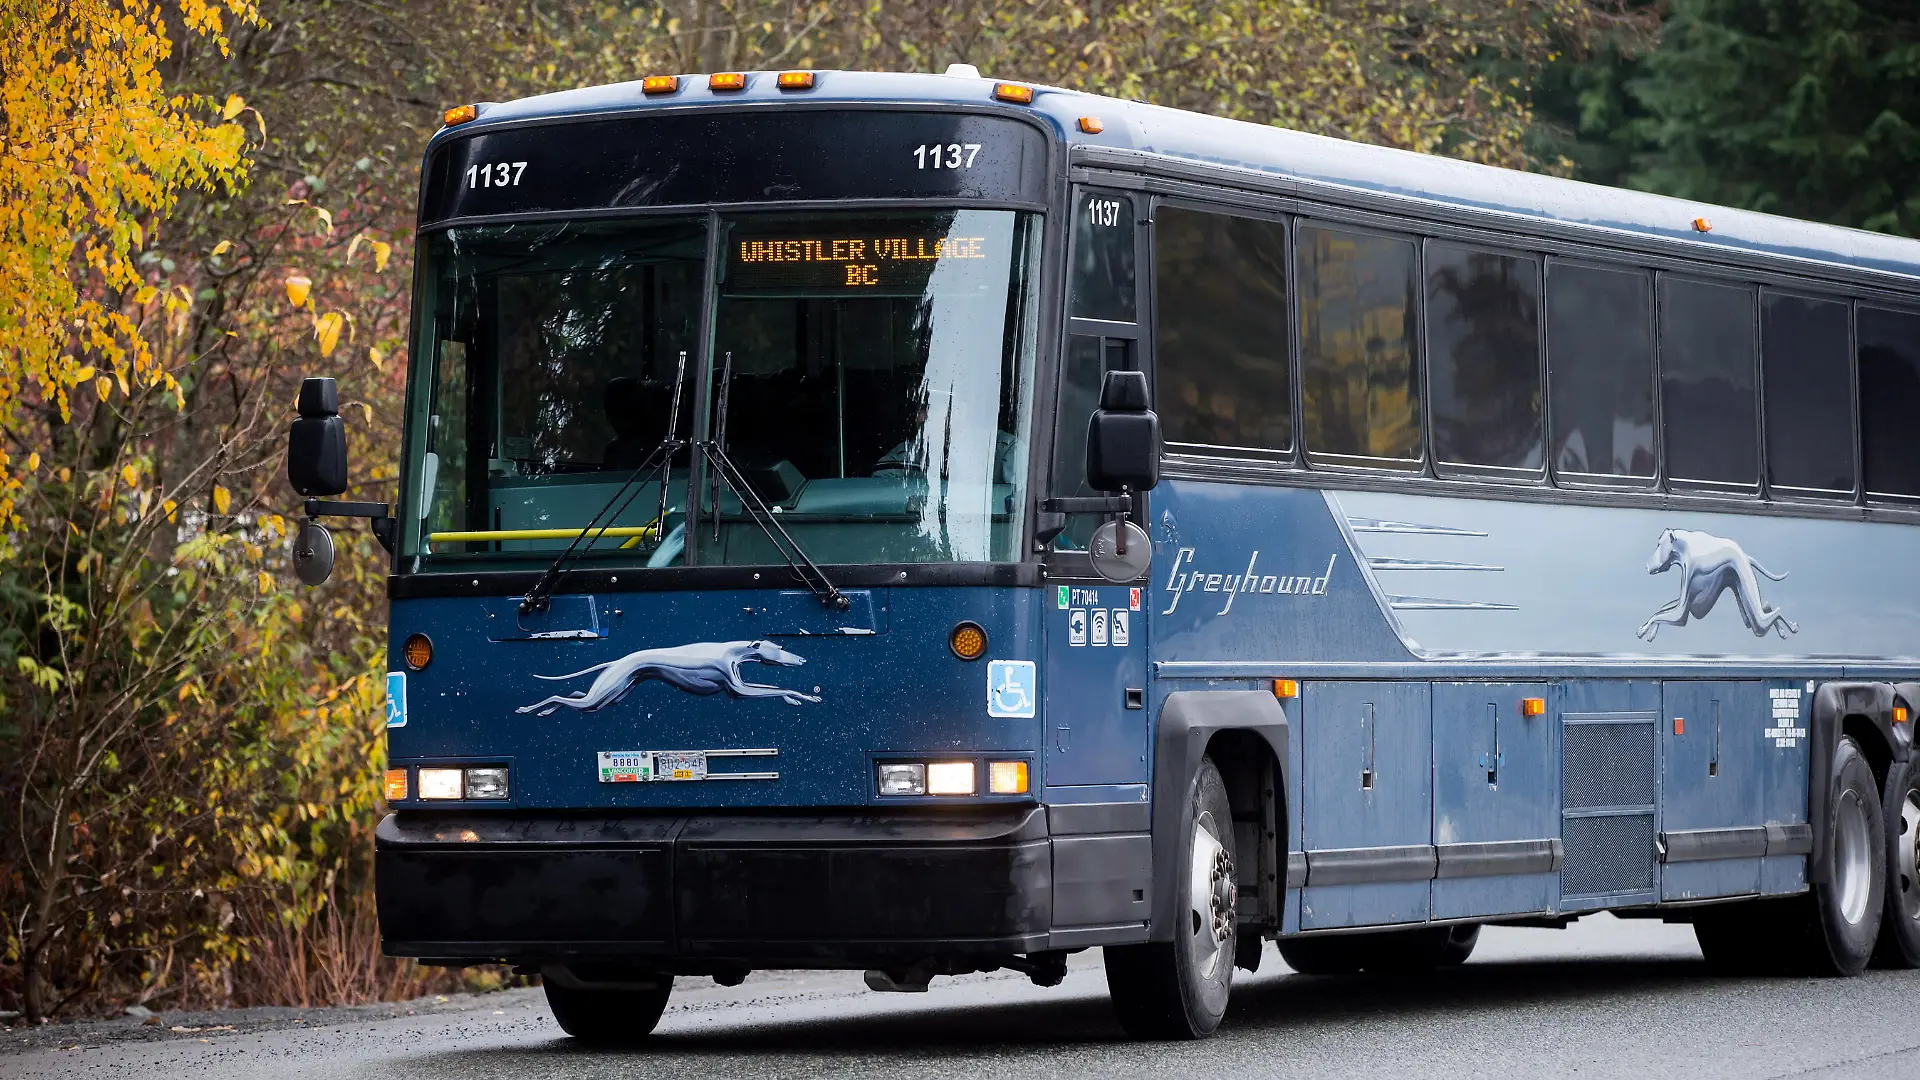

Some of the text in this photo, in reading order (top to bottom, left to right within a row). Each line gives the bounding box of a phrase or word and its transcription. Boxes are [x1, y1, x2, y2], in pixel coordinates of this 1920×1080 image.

[914, 143, 982, 170] 1137
[466, 161, 528, 189] 1137
[1088, 198, 1120, 227] 1137
[741, 237, 985, 263] WHISTLER VILLAGE
[845, 264, 878, 287] BC
[1161, 546, 1337, 616] Greyhound
[1072, 588, 1080, 605] PT
[1081, 589, 1099, 606] 70414
[613, 758, 639, 767] 8880
